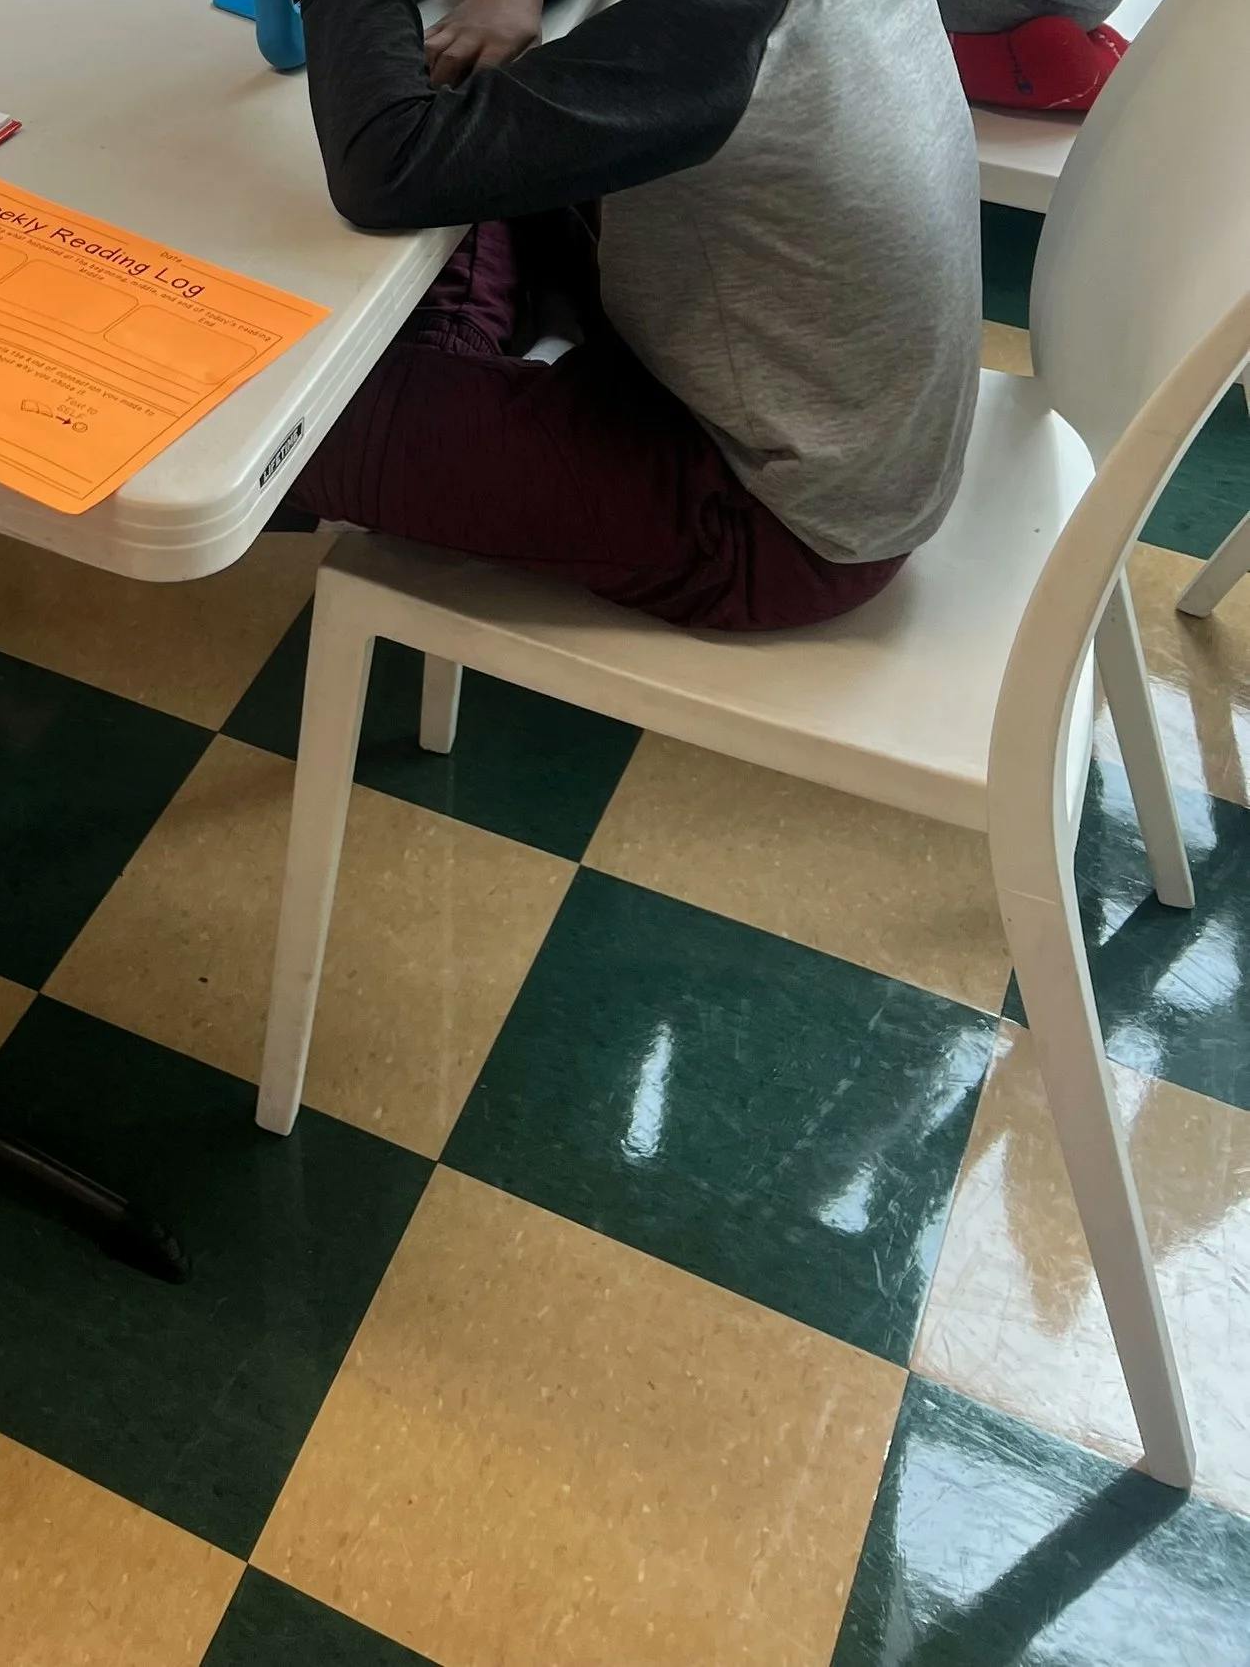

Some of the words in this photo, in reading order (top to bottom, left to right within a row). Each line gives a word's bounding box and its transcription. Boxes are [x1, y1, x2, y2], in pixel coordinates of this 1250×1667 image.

[49, 227, 150, 276] Reading
[155, 267, 205, 298] Log
[160, 251, 182, 263] Date
[79, 267, 104, 280] Middle
[198, 318, 215, 327] End
[26, 357, 45, 367] kind
[120, 399, 142, 411] made
[57, 405, 85, 419] SELF
[66, 396, 86, 409] Text
[87, 407, 98, 415] to
[262, 428, 301, 485] LIFETIME
